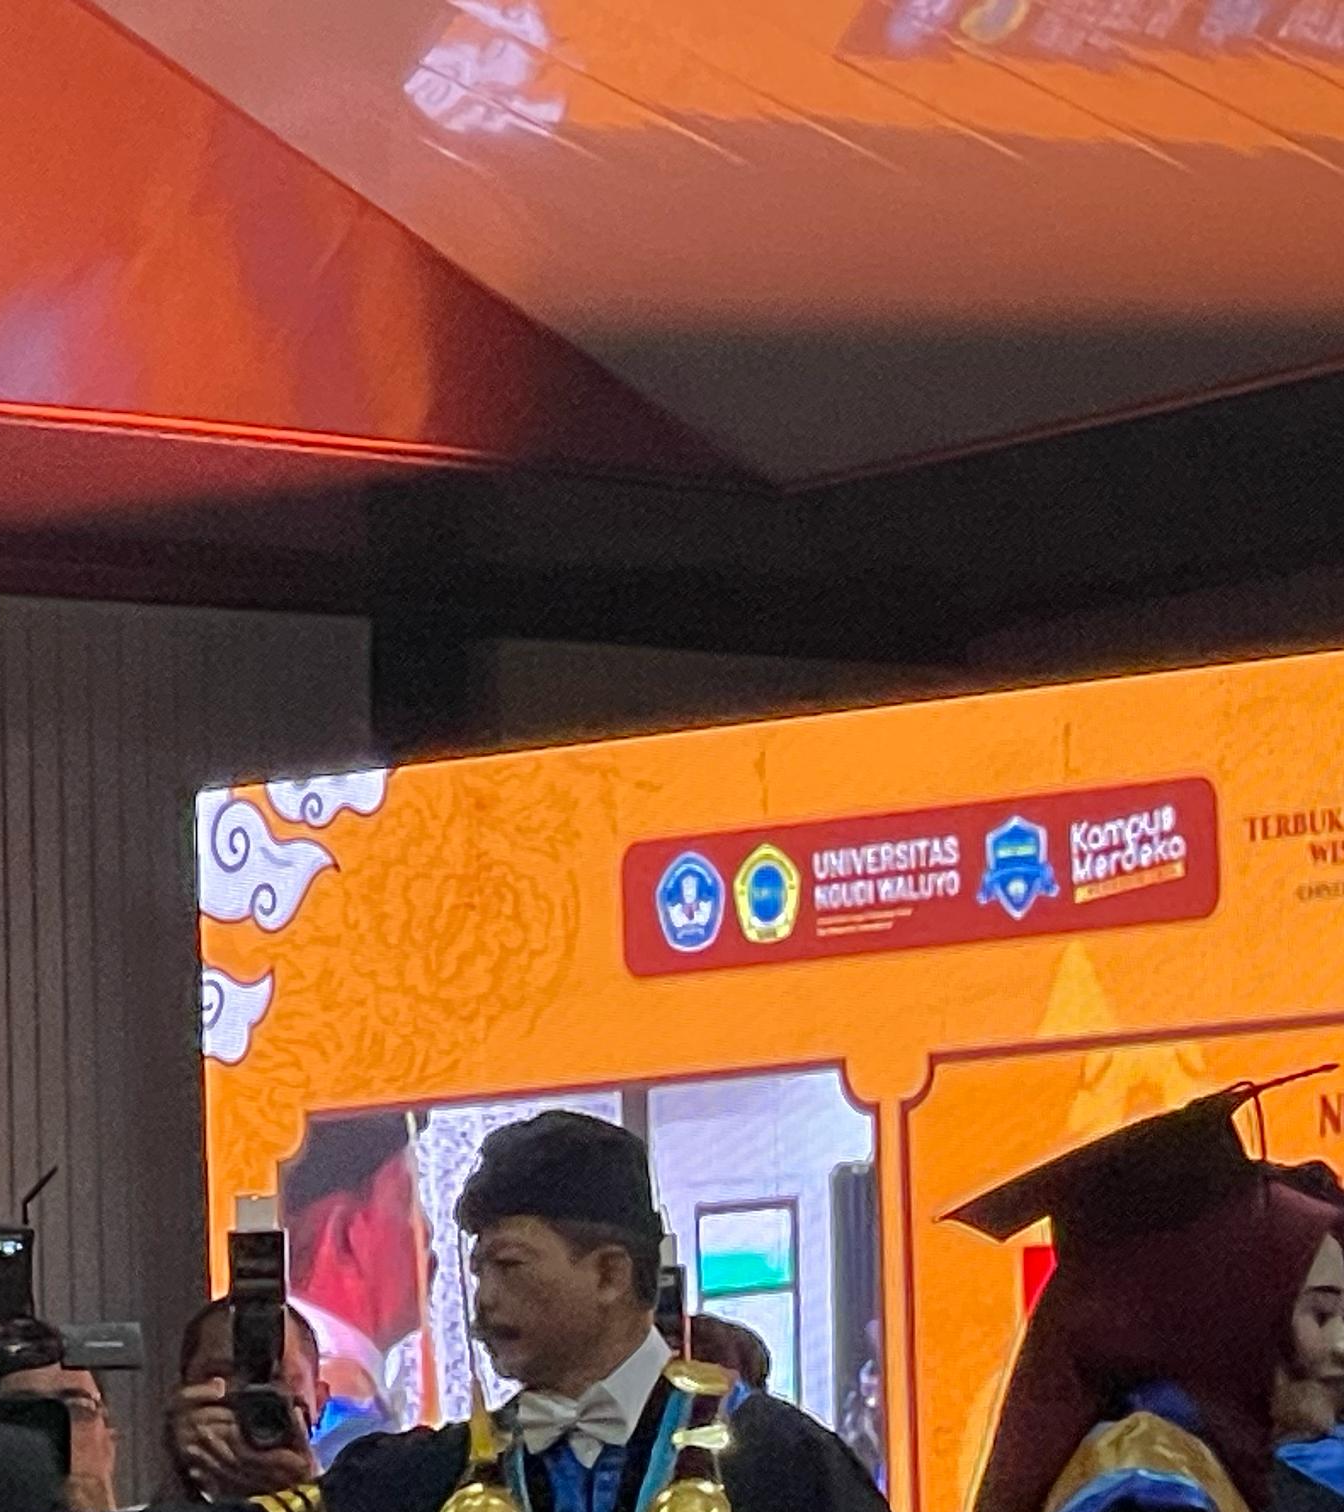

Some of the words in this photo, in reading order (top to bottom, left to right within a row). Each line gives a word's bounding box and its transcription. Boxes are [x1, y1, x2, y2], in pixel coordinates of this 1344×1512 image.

[1070, 805, 1175, 850] Kampus
[812, 835, 960, 880] UNIVERSITAS
[1072, 835, 1187, 884] Merdeka
